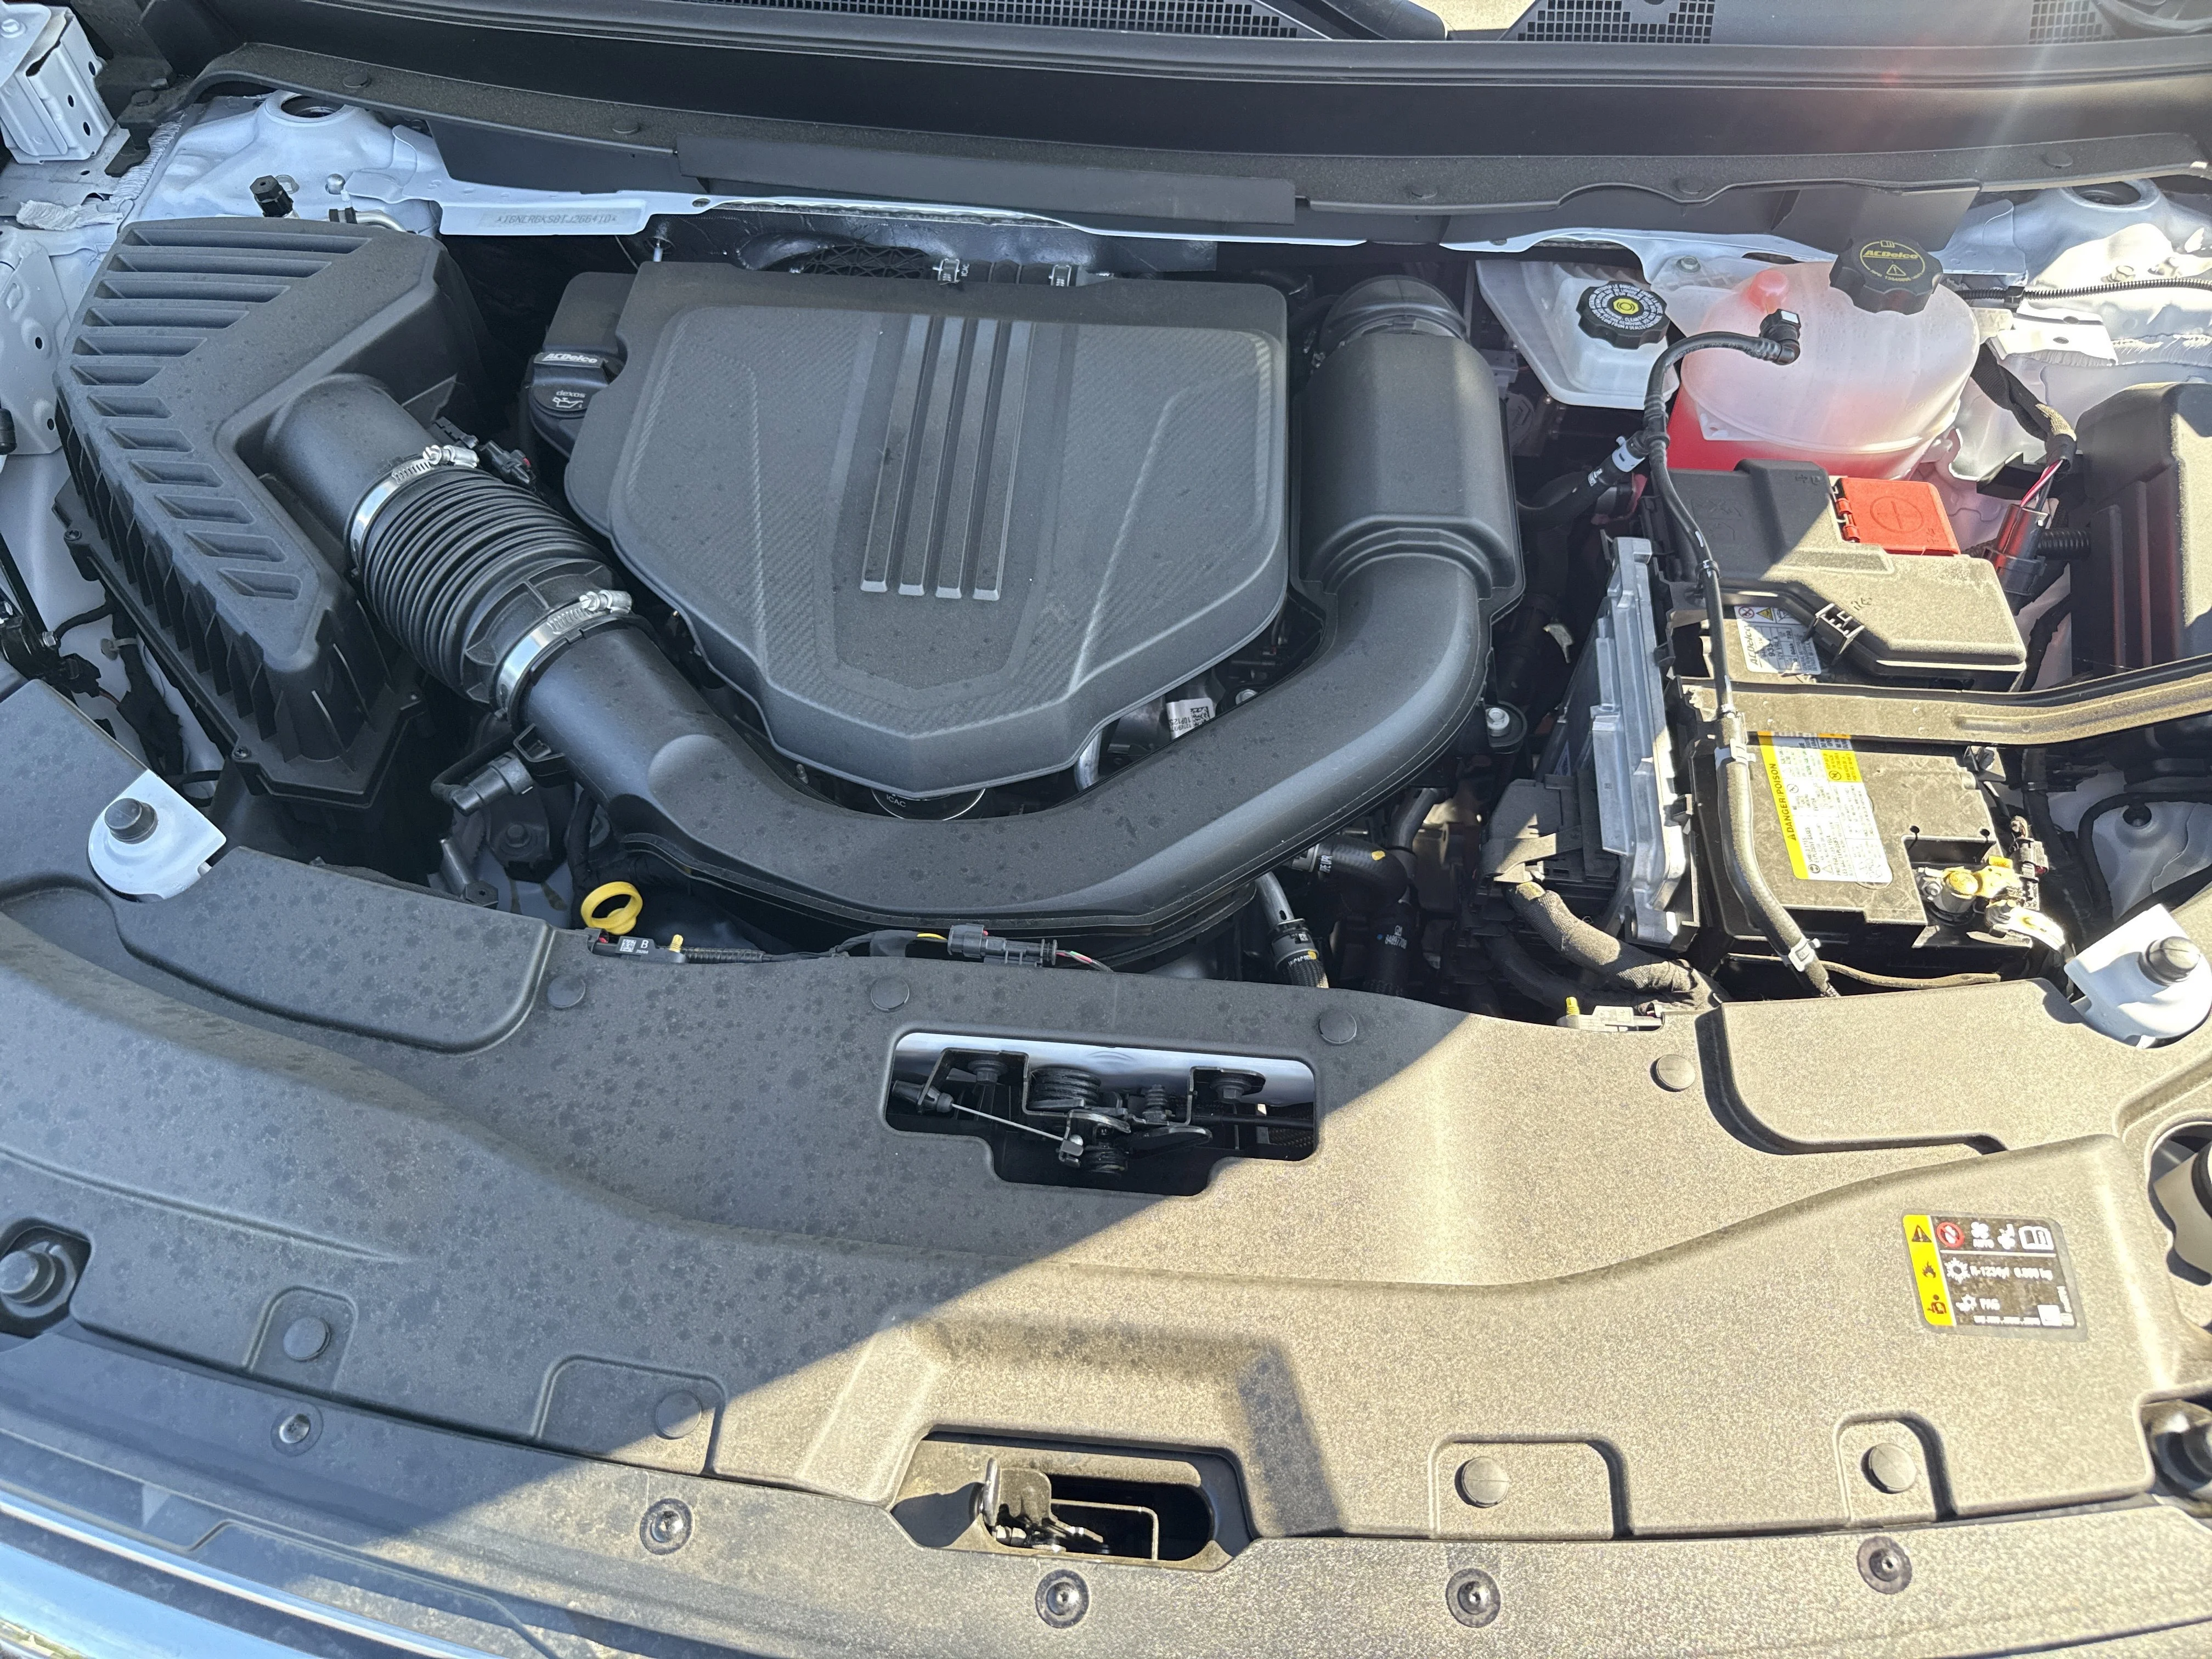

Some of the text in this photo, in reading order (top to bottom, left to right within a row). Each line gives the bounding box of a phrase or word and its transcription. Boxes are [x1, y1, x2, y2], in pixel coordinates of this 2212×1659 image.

[1864, 250, 1918, 259] ACDelco
[542, 353, 597, 364] ACDelco
[556, 390, 586, 398] dexos
[1744, 626, 1758, 665] ACDelco
[1769, 763, 1795, 833] DANGER/POISON
[640, 940, 649, 949] B
